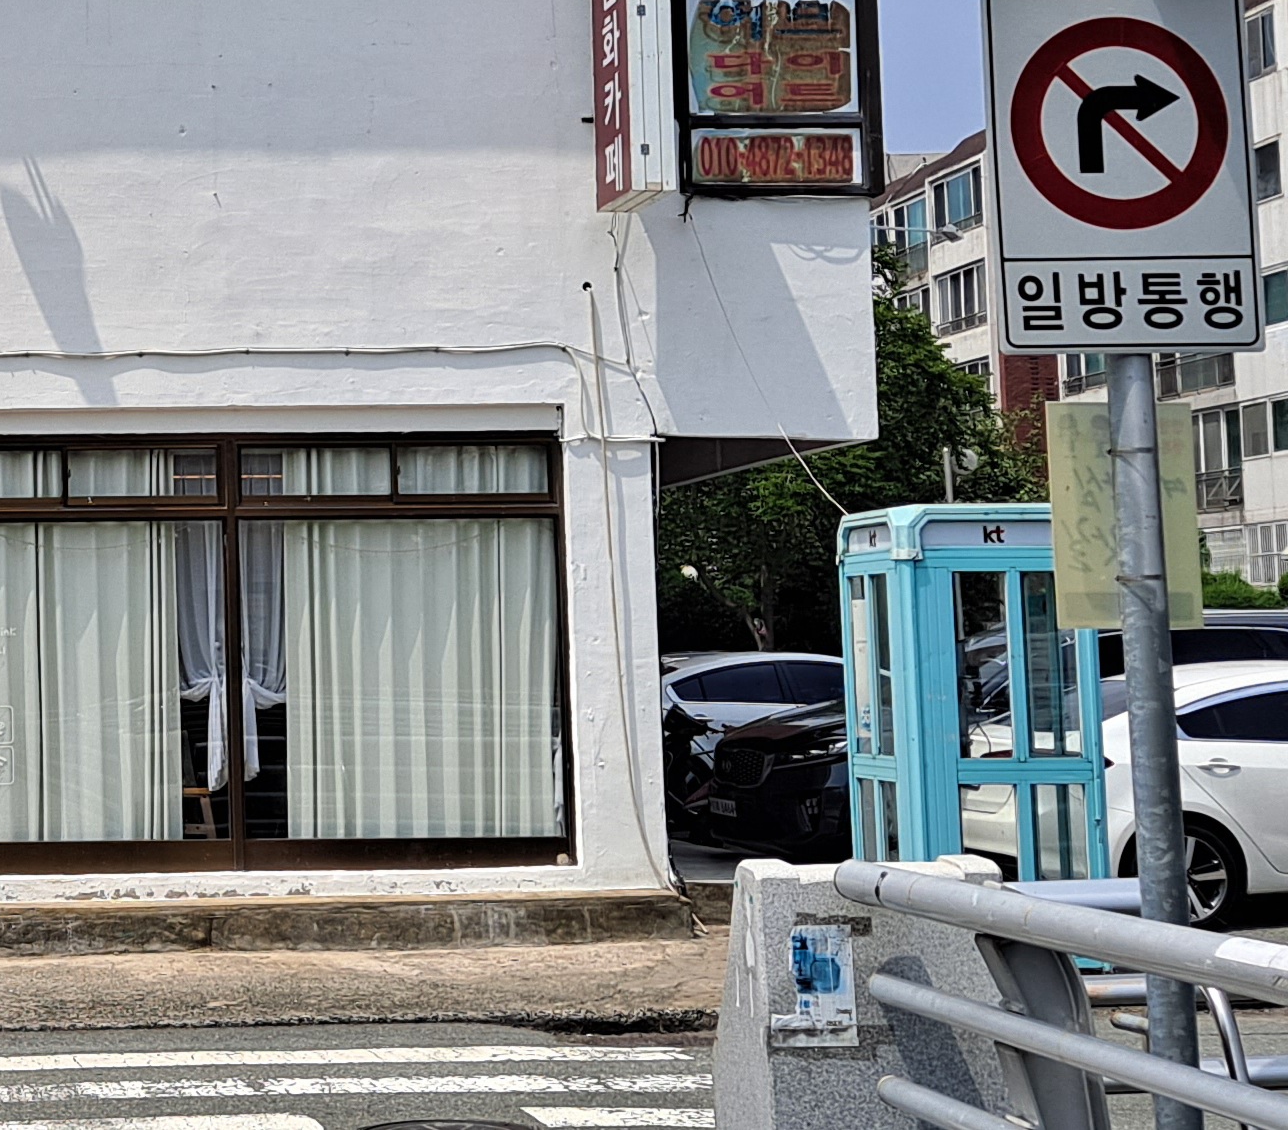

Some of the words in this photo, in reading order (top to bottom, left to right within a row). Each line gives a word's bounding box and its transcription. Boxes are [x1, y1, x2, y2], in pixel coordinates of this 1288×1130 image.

[707, 51, 842, 76] 다이
[709, 81, 843, 106] 어트
[700, 135, 853, 177] 010-4872-1348
[1018, 269, 1244, 331] 일방통행
[869, 529, 877, 548] kt
[983, 525, 1005, 544] kt
